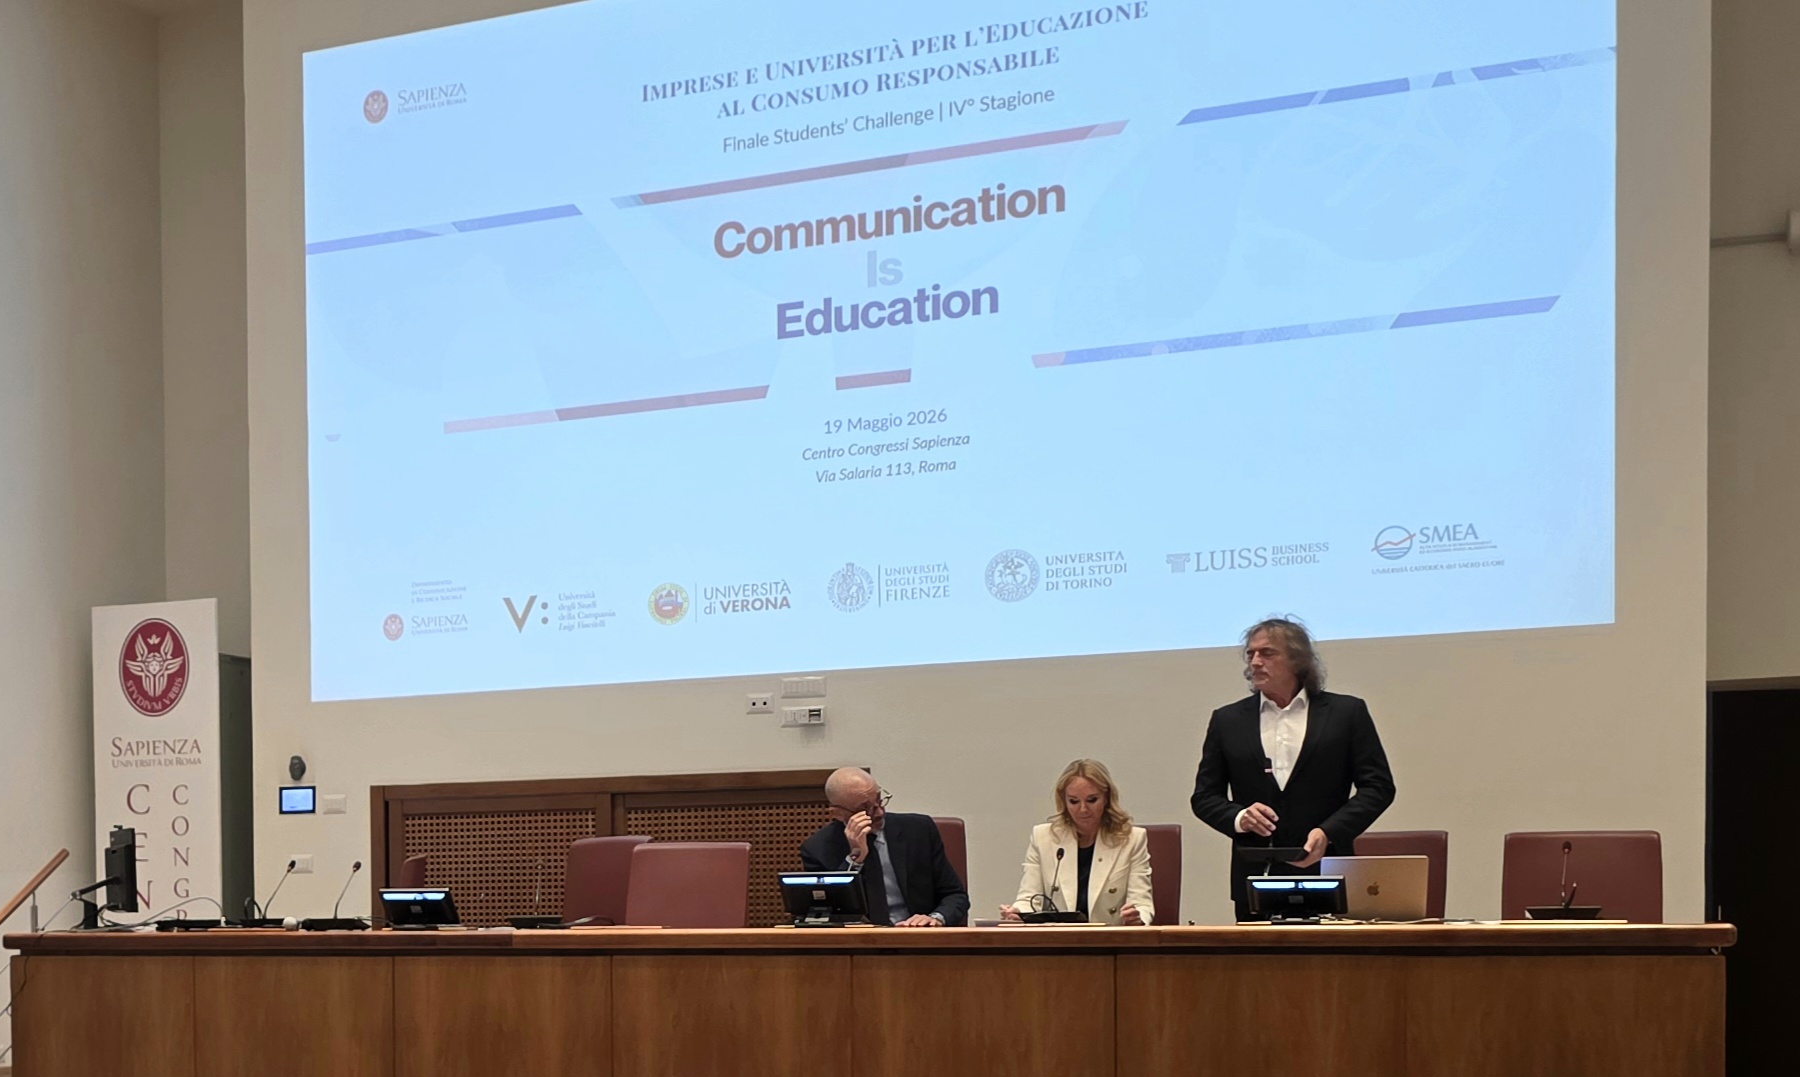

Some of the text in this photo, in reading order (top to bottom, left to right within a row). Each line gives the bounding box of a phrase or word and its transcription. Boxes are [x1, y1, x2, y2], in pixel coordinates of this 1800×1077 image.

[641, 71, 739, 102] IMPRESE
[746, 67, 759, 85] E
[766, 38, 905, 82] UNIVERSITÀ
[911, 33, 957, 57] PER
[716, 46, 1061, 119] AL CONSUMO RESPONSABILE
[398, 82, 467, 106] SAPIENZA
[723, 129, 770, 153] Finale
[853, 105, 935, 132] Challenge
[980, 86, 1056, 114] Stagione
[714, 182, 1066, 259] Communication
[867, 250, 904, 288] Is
[777, 283, 999, 340] Education
[824, 408, 947, 434] 19 Maggio 2026
[802, 435, 970, 461] Centro Congressi Sapienza
[815, 460, 957, 483] Via Salaria 113, Roma
[1419, 523, 1479, 543] SMEA
[1271, 542, 1330, 555] BUSINESS
[1045, 562, 1128, 580] DEGLI STUDI
[1194, 548, 1268, 573] LUISS
[1271, 554, 1321, 567] SCHOOL
[703, 579, 792, 600] UNIVERSITÀ
[885, 574, 950, 588] DEGLI STUDI
[1045, 577, 1113, 592] DI TORINO
[885, 584, 951, 602] FIRENZE
[703, 598, 792, 615] di VERONA
[411, 614, 468, 629] SAPIENZA
[111, 736, 201, 757] SAPIENZA
